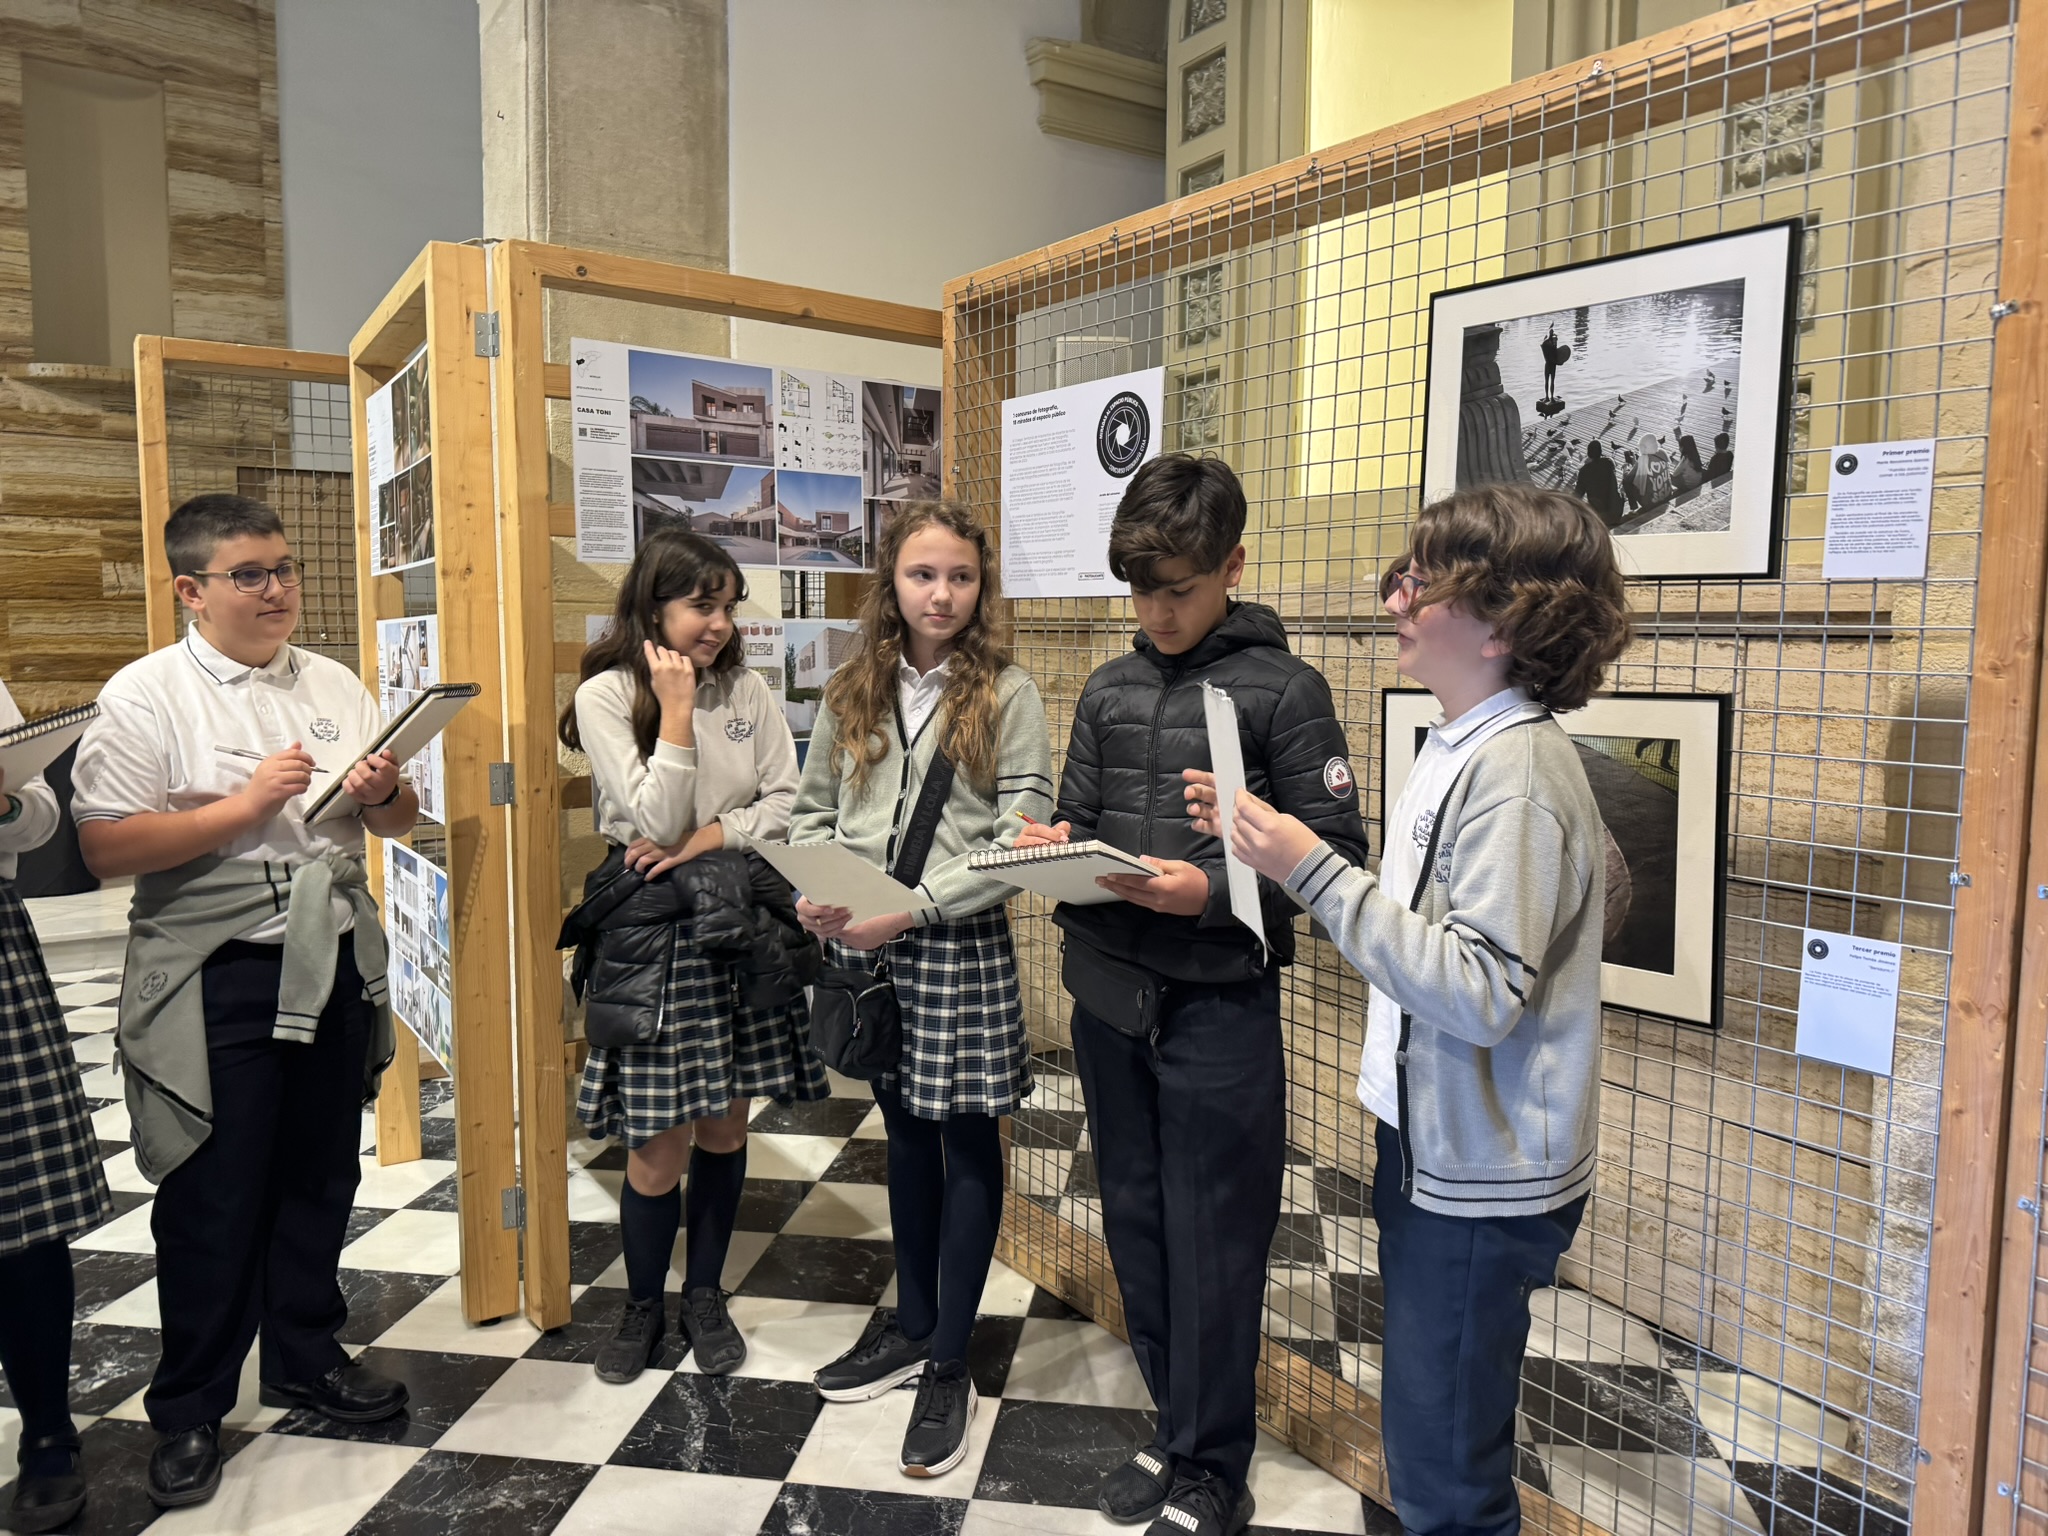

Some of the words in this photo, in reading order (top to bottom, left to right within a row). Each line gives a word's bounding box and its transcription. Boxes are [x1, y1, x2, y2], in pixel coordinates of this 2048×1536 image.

[1036, 413, 1051, 421] espacio
[1099, 416, 1108, 440] MIRADAS
[1110, 396, 1124, 410] ESPACIO
[1905, 448, 1930, 456] premio
[1108, 464, 1126, 474] CONCURSO
[903, 829, 926, 876] BIMBA
[925, 780, 943, 816] LOLA
[1873, 949, 1896, 957] premio
[1133, 1451, 1163, 1476] PUMA
[1160, 1504, 1199, 1533] PUMA
